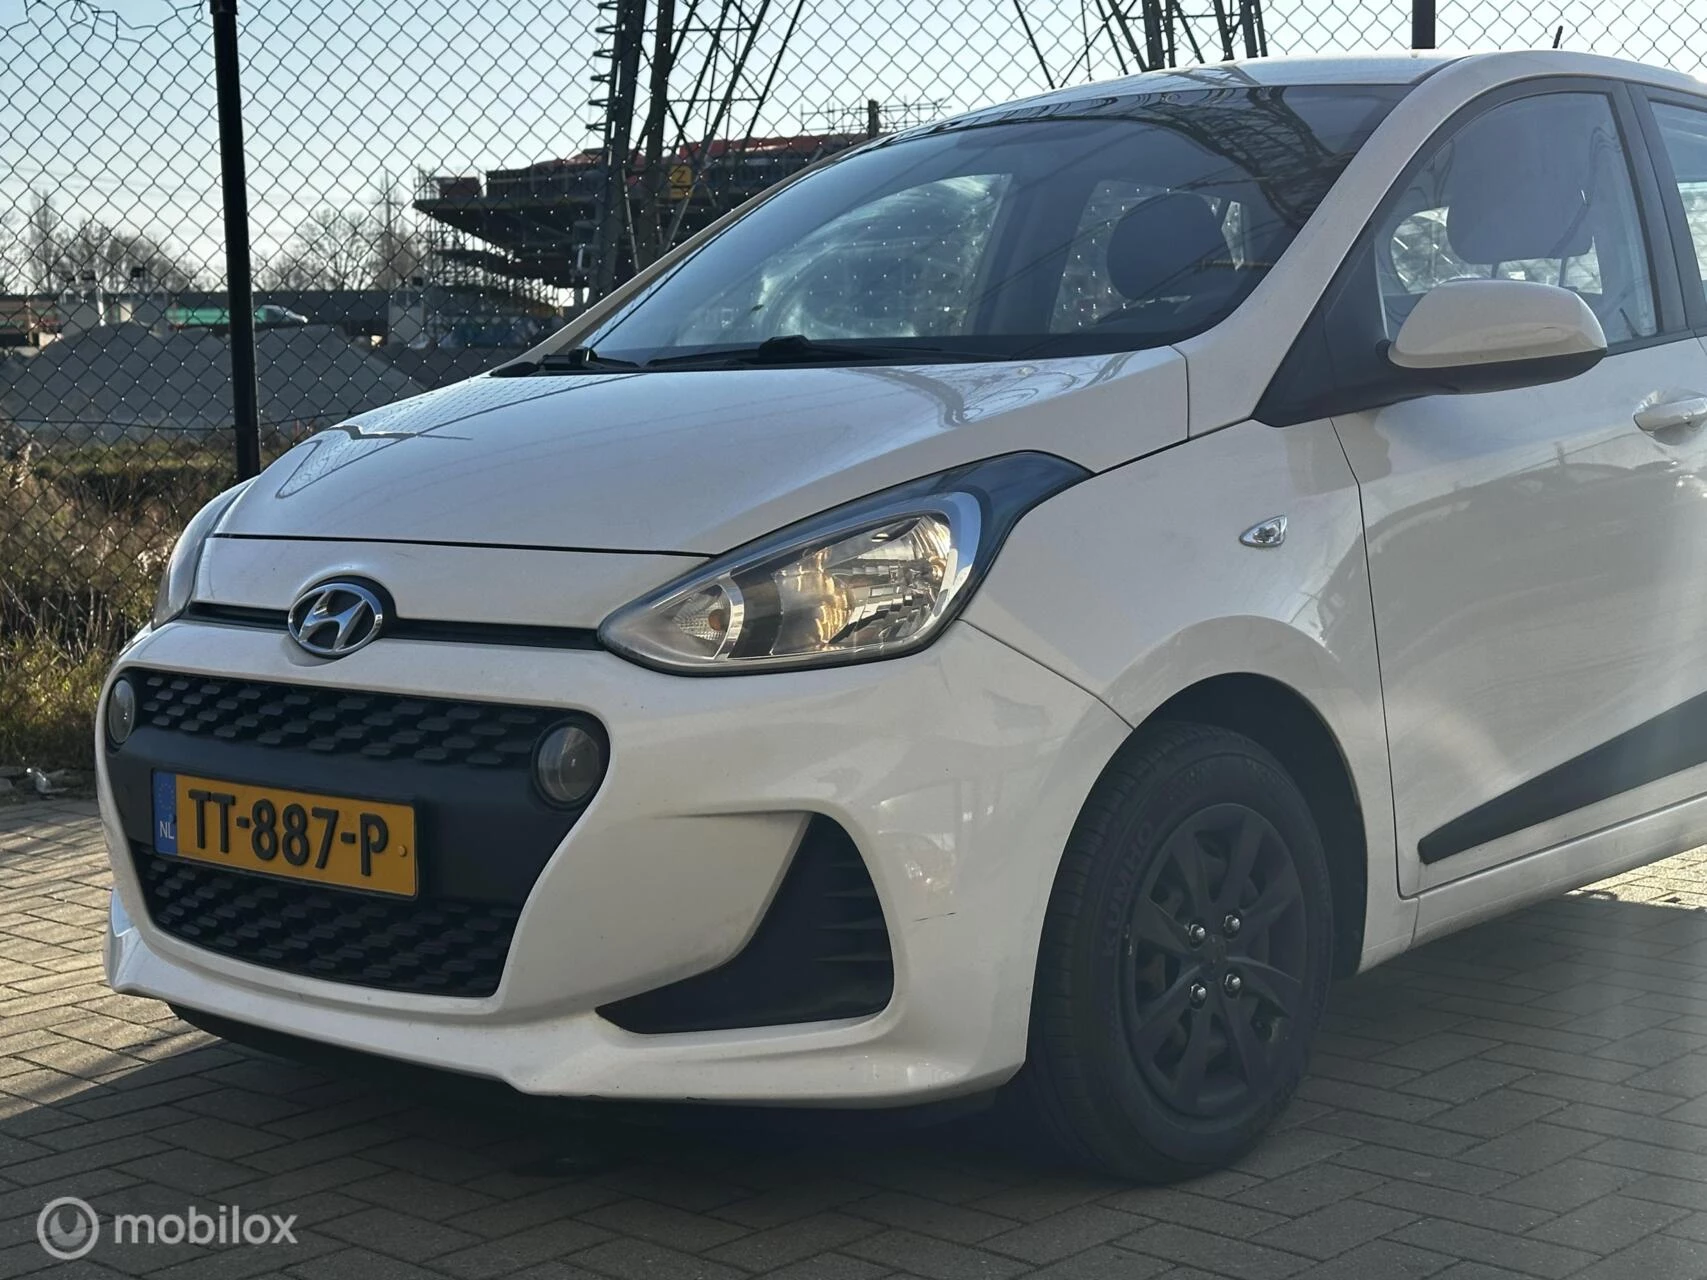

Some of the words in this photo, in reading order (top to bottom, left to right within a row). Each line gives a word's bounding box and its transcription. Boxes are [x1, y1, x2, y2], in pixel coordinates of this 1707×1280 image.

[159, 820, 175, 841] NL
[188, 789, 389, 877] TT-887-P
[1101, 821, 1154, 957] KUMHO
